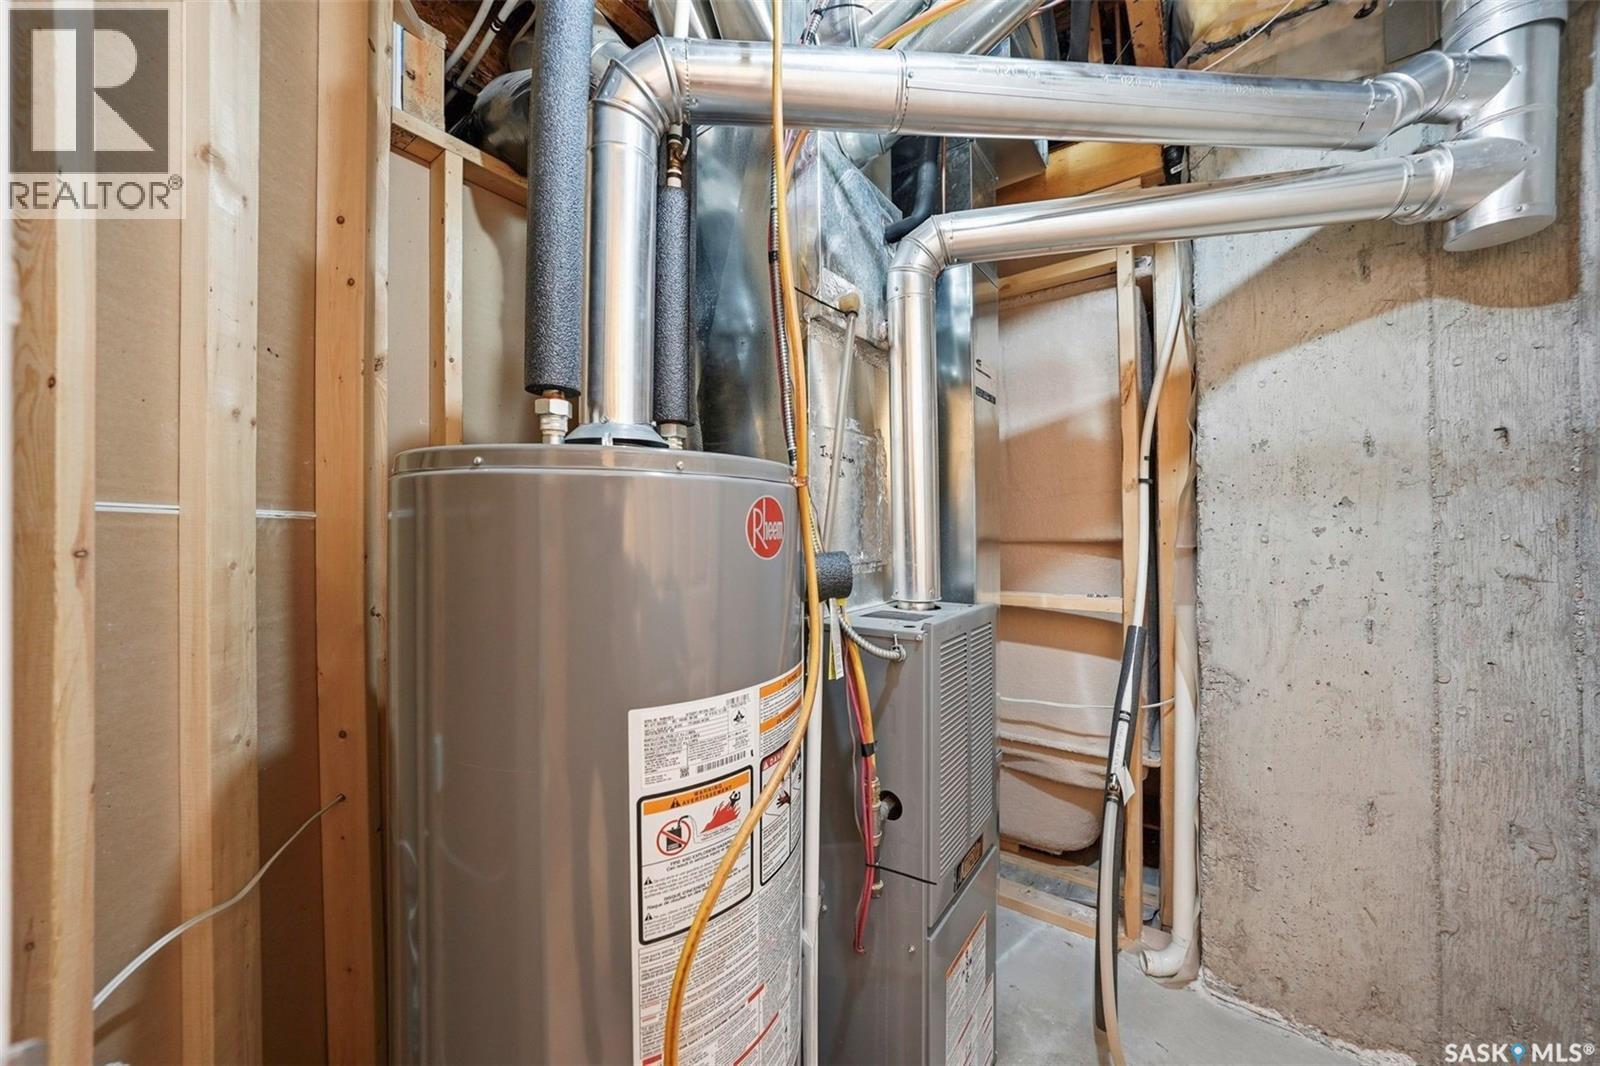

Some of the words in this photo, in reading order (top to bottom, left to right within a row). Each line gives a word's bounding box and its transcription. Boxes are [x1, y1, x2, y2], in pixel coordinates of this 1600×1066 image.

[753, 497, 783, 549] Rheem
[682, 785, 732, 806] AVERTISSEMENT
[694, 784, 722, 796] WARNING
